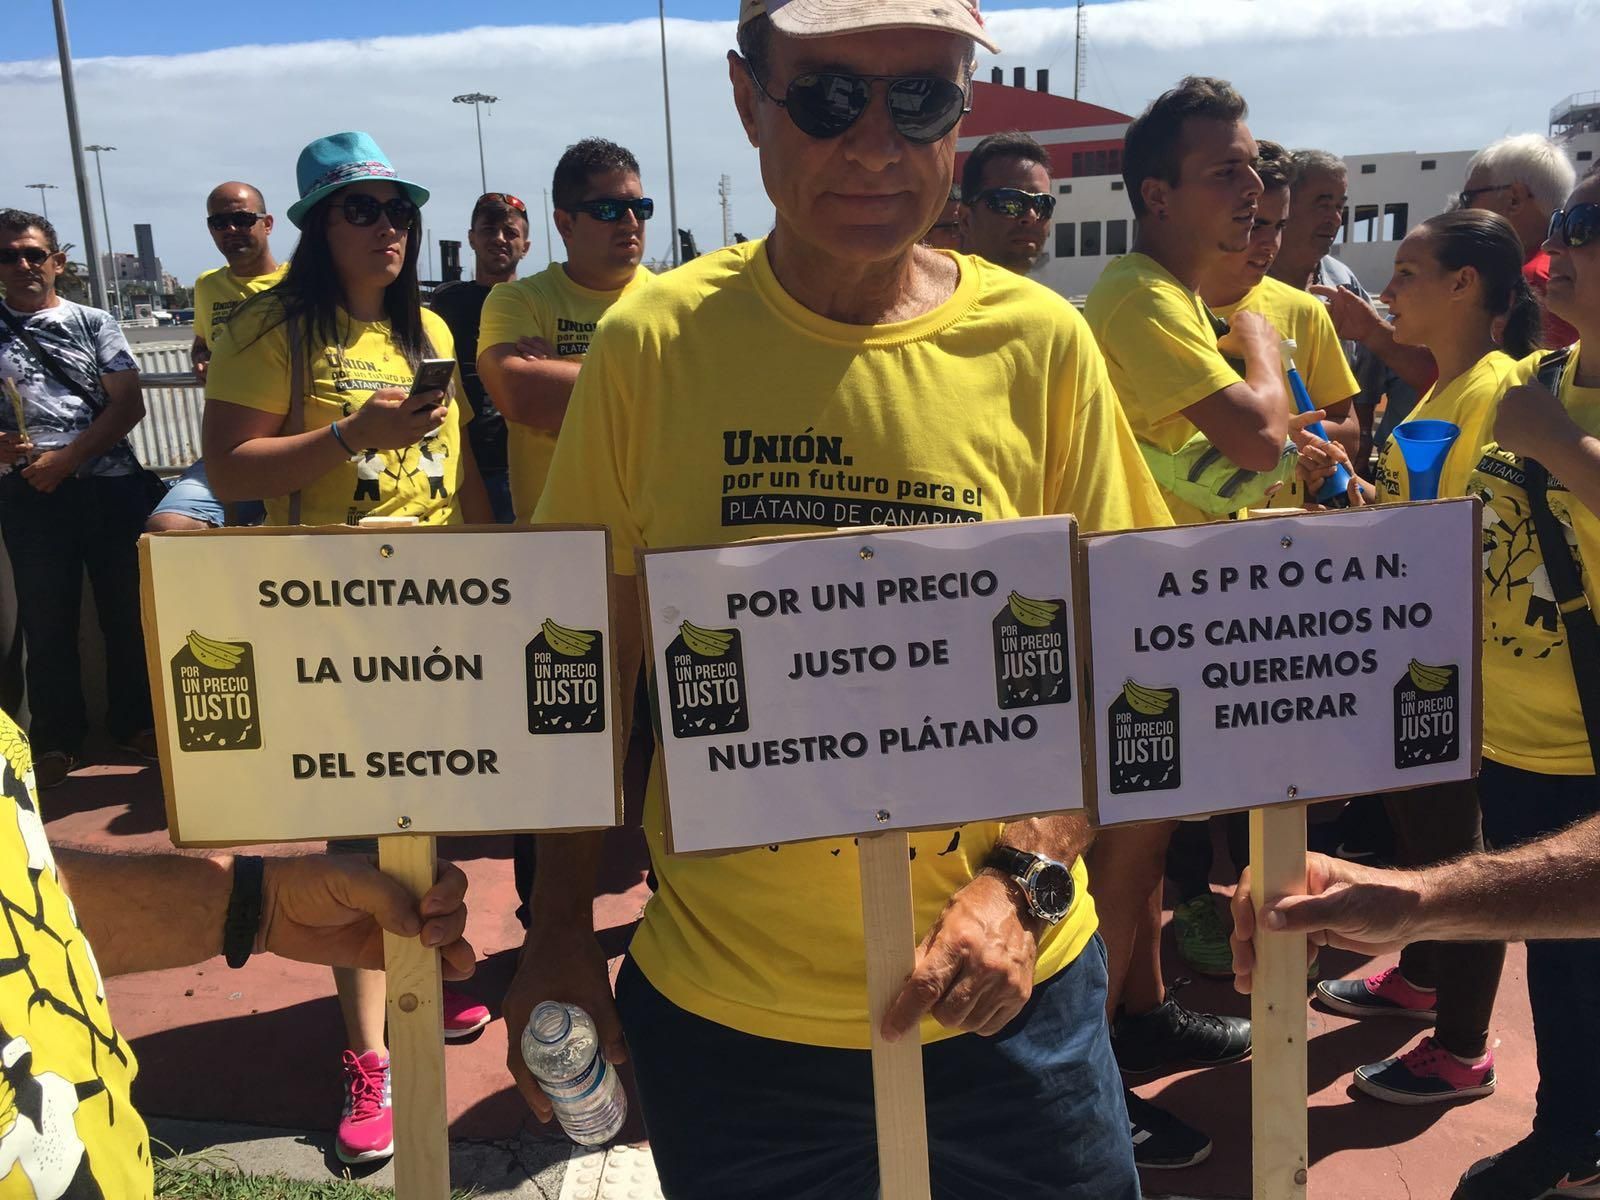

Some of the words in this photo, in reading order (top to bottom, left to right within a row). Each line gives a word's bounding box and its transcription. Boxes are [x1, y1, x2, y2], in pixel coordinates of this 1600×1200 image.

[722, 472, 764, 493] por
[770, 471, 800, 488] un
[809, 469, 889, 494] futuro
[897, 479, 955, 502] para
[963, 487, 982, 506] el
[730, 496, 825, 521] PLÁTANO
[834, 503, 862, 524] DE
[870, 506, 976, 528] CANARI
[258, 578, 512, 608] SOLICITAMOS
[726, 588, 802, 620] POR
[811, 581, 865, 612] UN
[877, 569, 998, 605] PRECIO
[1001, 625, 1018, 636] POR
[1001, 638, 1018, 652] UN
[1020, 632, 1062, 650] PRECIO
[1134, 622, 1195, 653] LOS
[1204, 607, 1373, 646] CANARIOS
[1382, 602, 1433, 631] NO
[180, 666, 200, 678] POR
[296, 657, 342, 683] LA
[353, 645, 483, 682] UNIÓN
[534, 652, 552, 663] POR
[534, 664, 551, 679] UN
[554, 663, 597, 678] PRECIO
[674, 654, 692, 666] POR
[675, 667, 692, 681] UN
[695, 662, 737, 680] PRECIO
[787, 644, 897, 680] JUSTO
[908, 639, 950, 668] DE
[1001, 649, 1063, 680] JUSTO
[1202, 648, 1378, 689] QUEREMOS
[182, 678, 200, 693] UN
[203, 676, 249, 693] PRECIO
[533, 679, 597, 705] JUSTO
[676, 678, 739, 709] JUSTO
[1401, 690, 1416, 702] POR
[183, 693, 251, 721] JUSTO
[1116, 712, 1132, 723] POR
[1215, 692, 1358, 730] EMIGRAR
[1401, 702, 1415, 717] UN
[1418, 695, 1453, 714] PRECIO
[1116, 724, 1131, 739] UN
[1134, 720, 1174, 738] PRECIO
[1399, 710, 1453, 742] JUSTO
[708, 731, 869, 772] NUESTRO
[879, 713, 1039, 755] PLÁTANO
[1115, 736, 1174, 766] JUSTO
[292, 752, 356, 780] DEL
[366, 749, 500, 778] SECTOR
